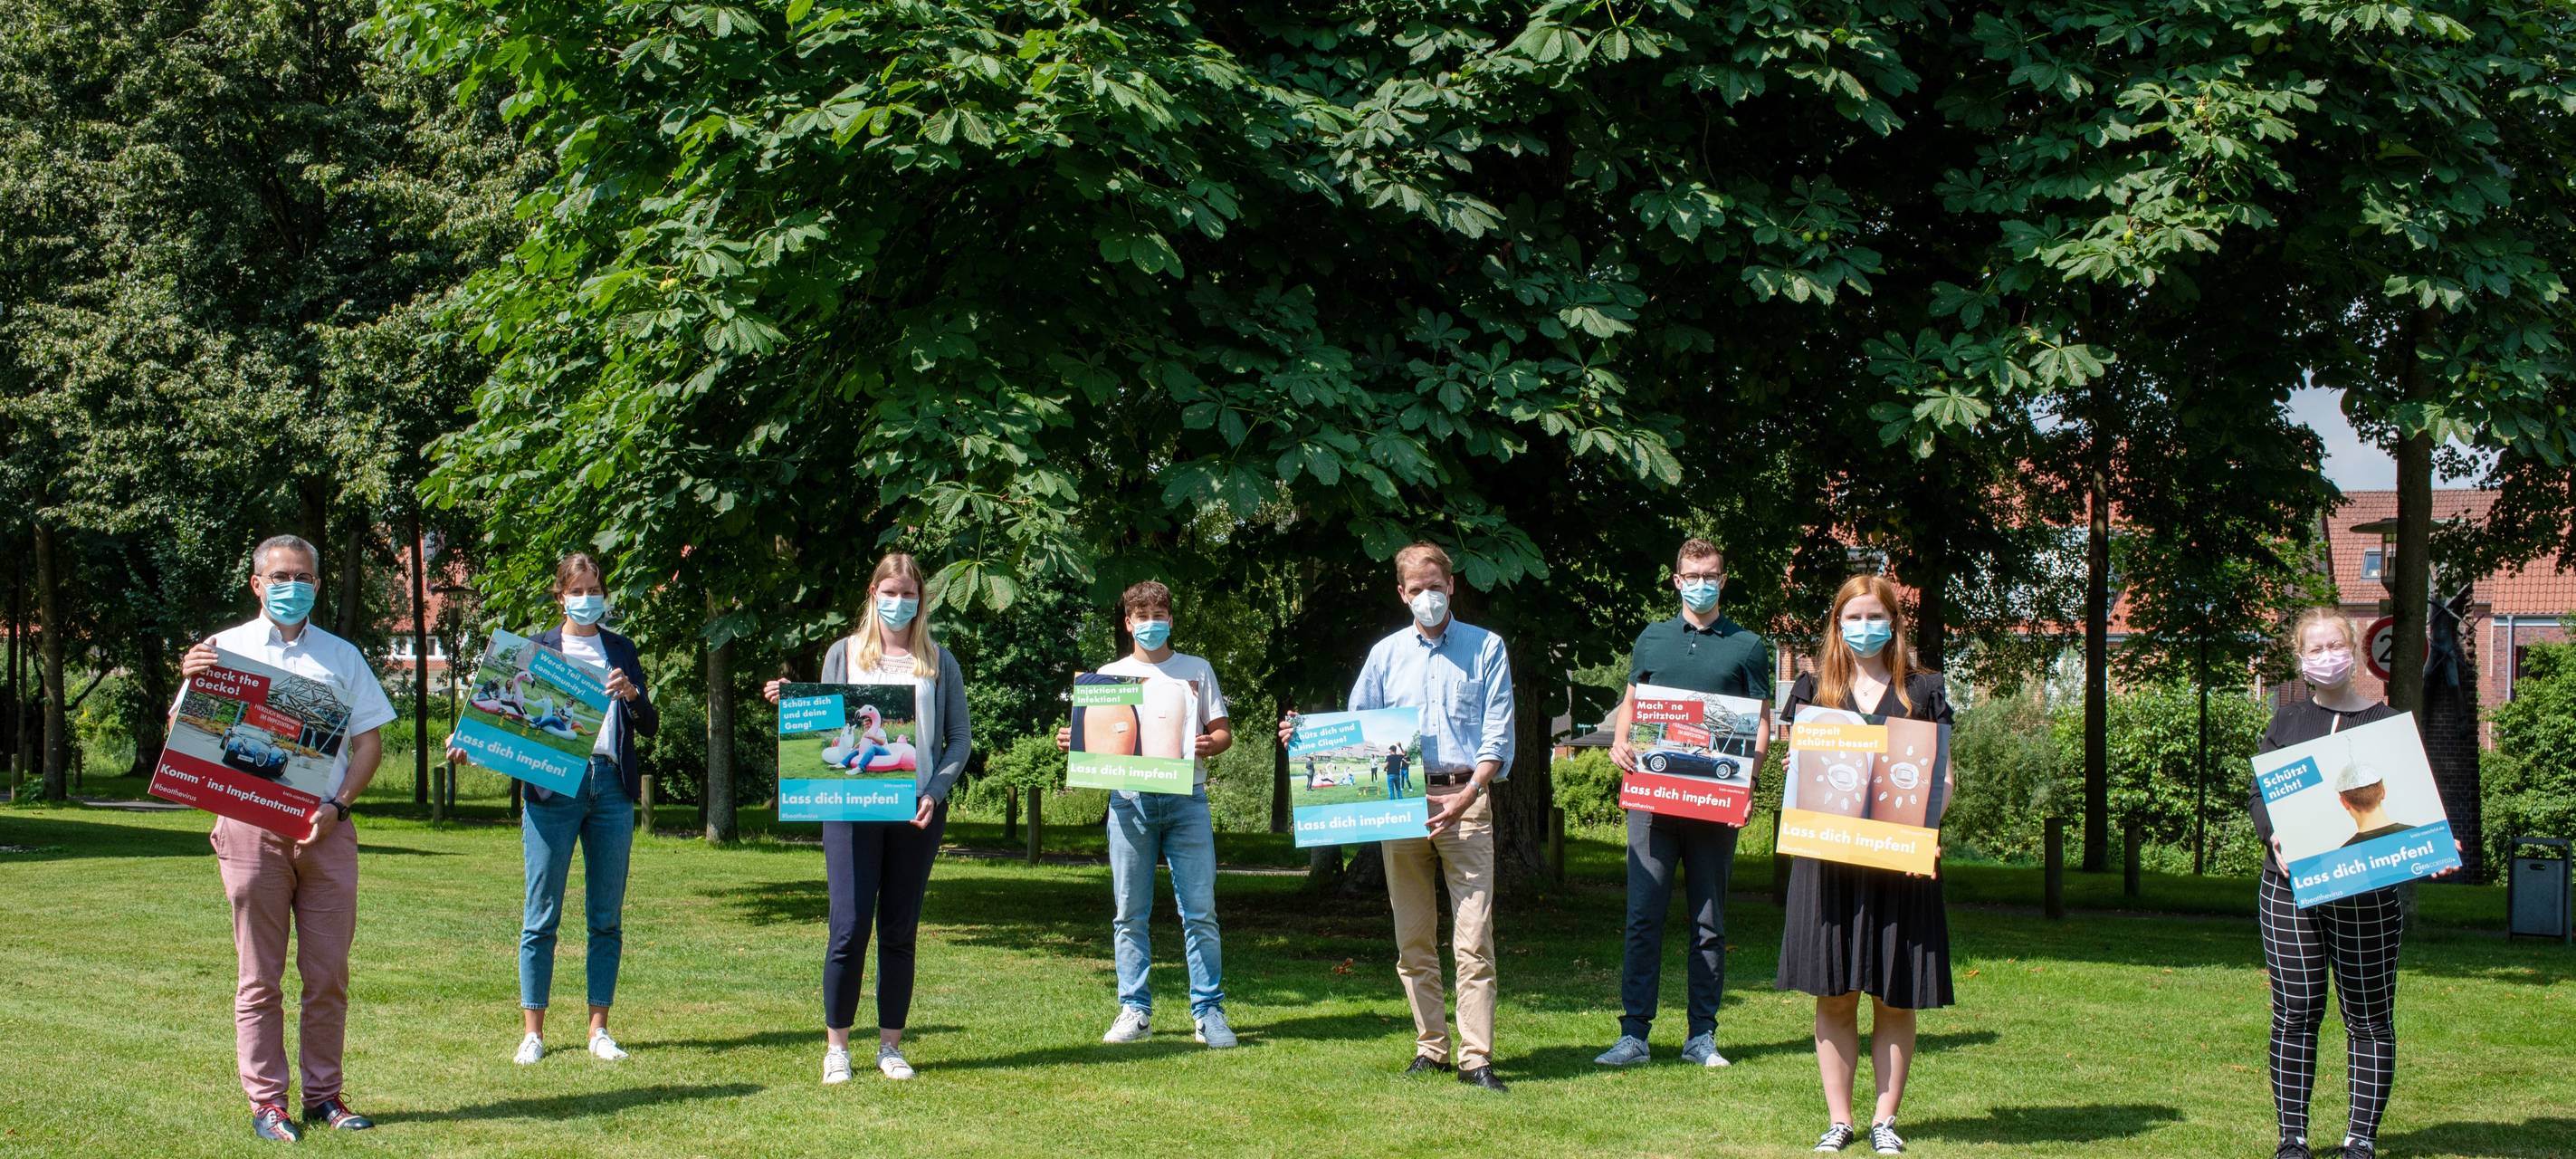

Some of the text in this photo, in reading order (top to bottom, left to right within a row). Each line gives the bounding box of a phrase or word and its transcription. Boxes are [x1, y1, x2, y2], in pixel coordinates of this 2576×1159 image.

[2379, 635, 2392, 663] 2
[540, 653, 565, 672] Werde
[567, 668, 581, 681] Teil
[196, 677, 241, 695] Gecko!
[239, 674, 259, 686] the
[1077, 686, 1116, 695] Injektion
[782, 697, 831, 708] Schütz dich
[1077, 695, 1121, 704] Infektion!
[784, 708, 827, 719] und deine
[1636, 711, 1689, 721] Spritztour!
[785, 721, 811, 730] Gang!
[1320, 726, 1338, 737] dich
[1340, 723, 1356, 733] und
[1797, 725, 1840, 737] Doppelt
[1318, 735, 1347, 746] Clique!
[1838, 738, 1877, 748] besser!
[456, 730, 484, 748] Lass
[487, 742, 514, 759] dich
[516, 751, 567, 777] impfen!
[1070, 762, 1178, 780] Lass dich impfen!
[2263, 764, 2307, 788] Schützt
[154, 782, 196, 802] #beatthevirus
[207, 778, 224, 791] ins
[226, 785, 306, 817] Impfzentrum!
[1624, 781, 1731, 808] Lass dich impfen!
[2268, 779, 2303, 800] nicht!
[782, 791, 899, 808] Lass dich impfen!
[1297, 811, 1412, 831] Lass dich impfen!
[1781, 822, 1816, 839] Lass
[1819, 827, 1851, 844] dich
[1856, 833, 1915, 855] impfen!
[2294, 840, 2434, 889] Lass dich impfen!
[2300, 891, 2344, 905] #beatthevirus
